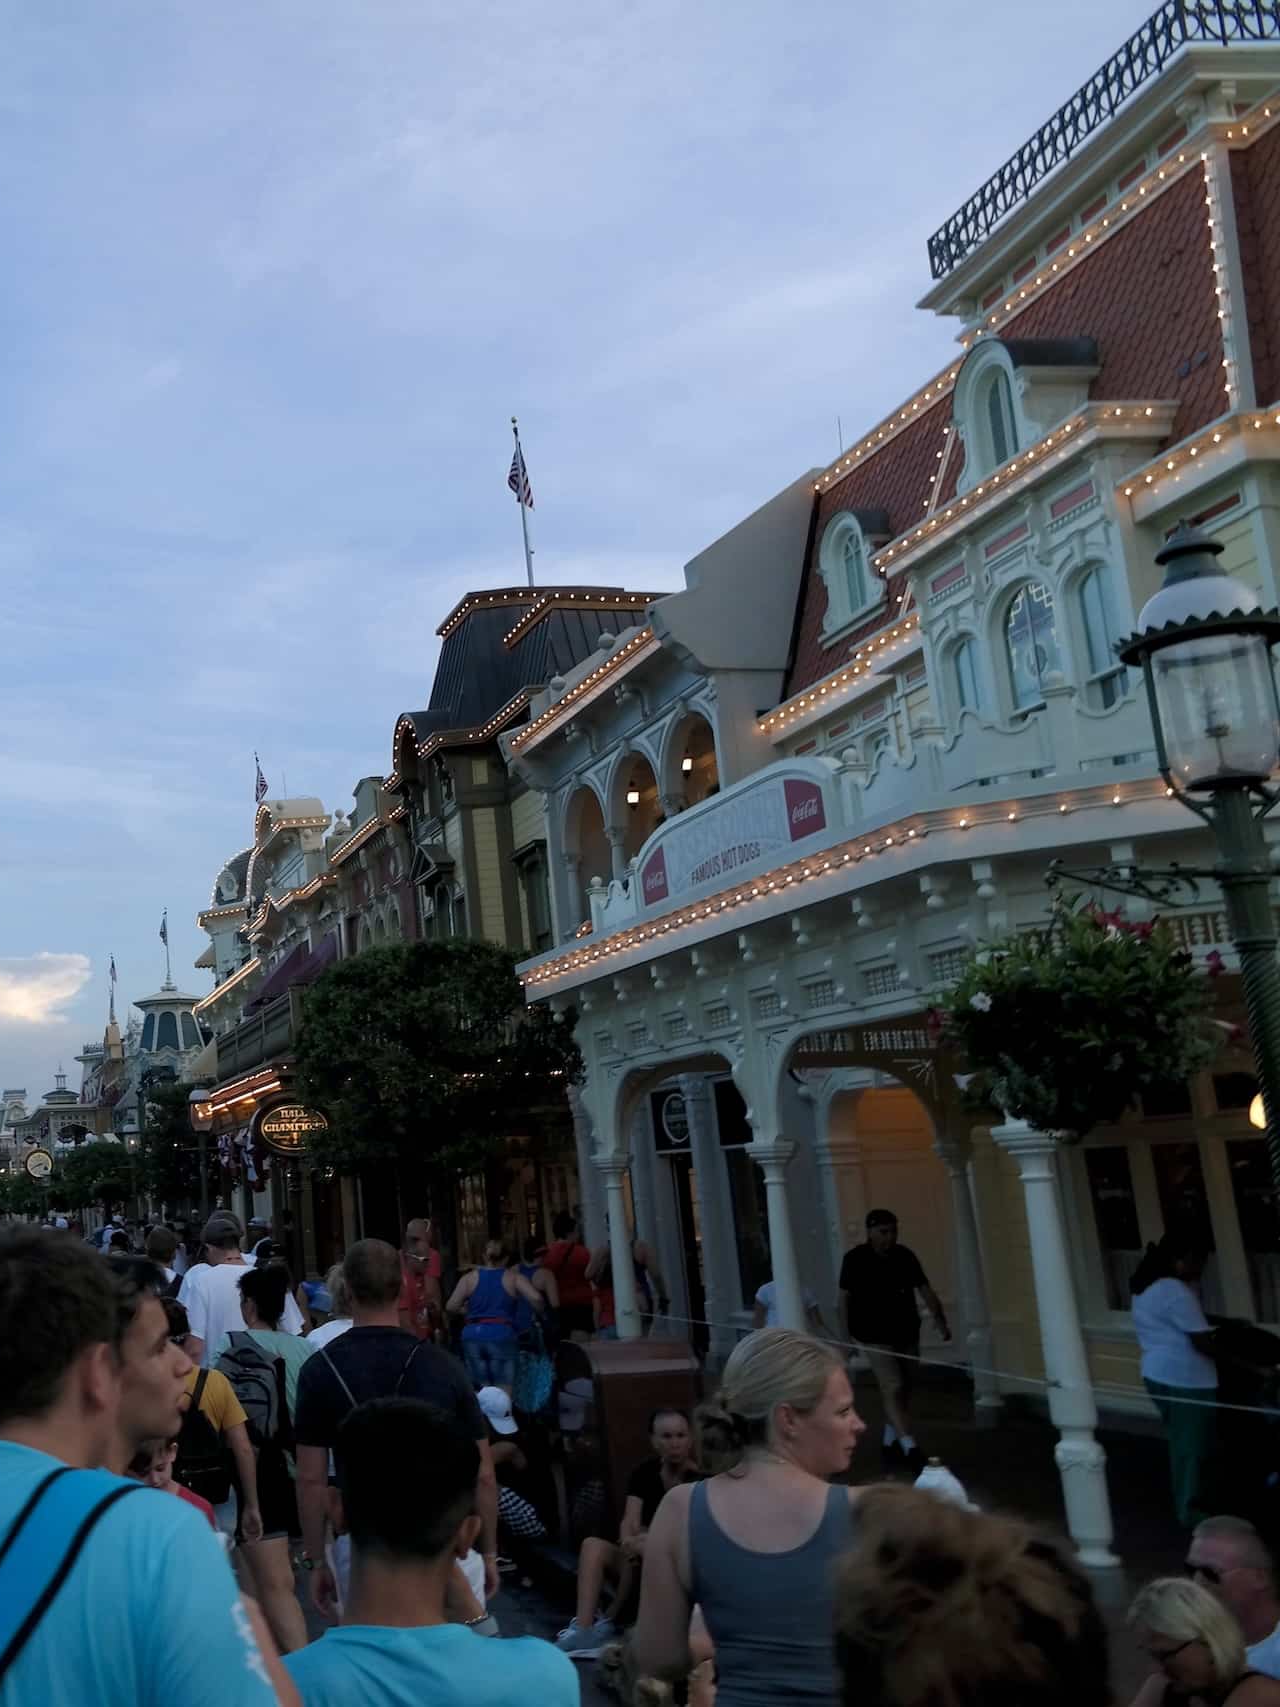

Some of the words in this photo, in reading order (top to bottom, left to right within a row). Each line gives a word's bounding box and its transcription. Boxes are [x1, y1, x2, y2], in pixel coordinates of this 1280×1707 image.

[689, 856, 721, 886] FAMOUS
[720, 846, 739, 873] HOT
[737, 841, 761, 865] DOGS
